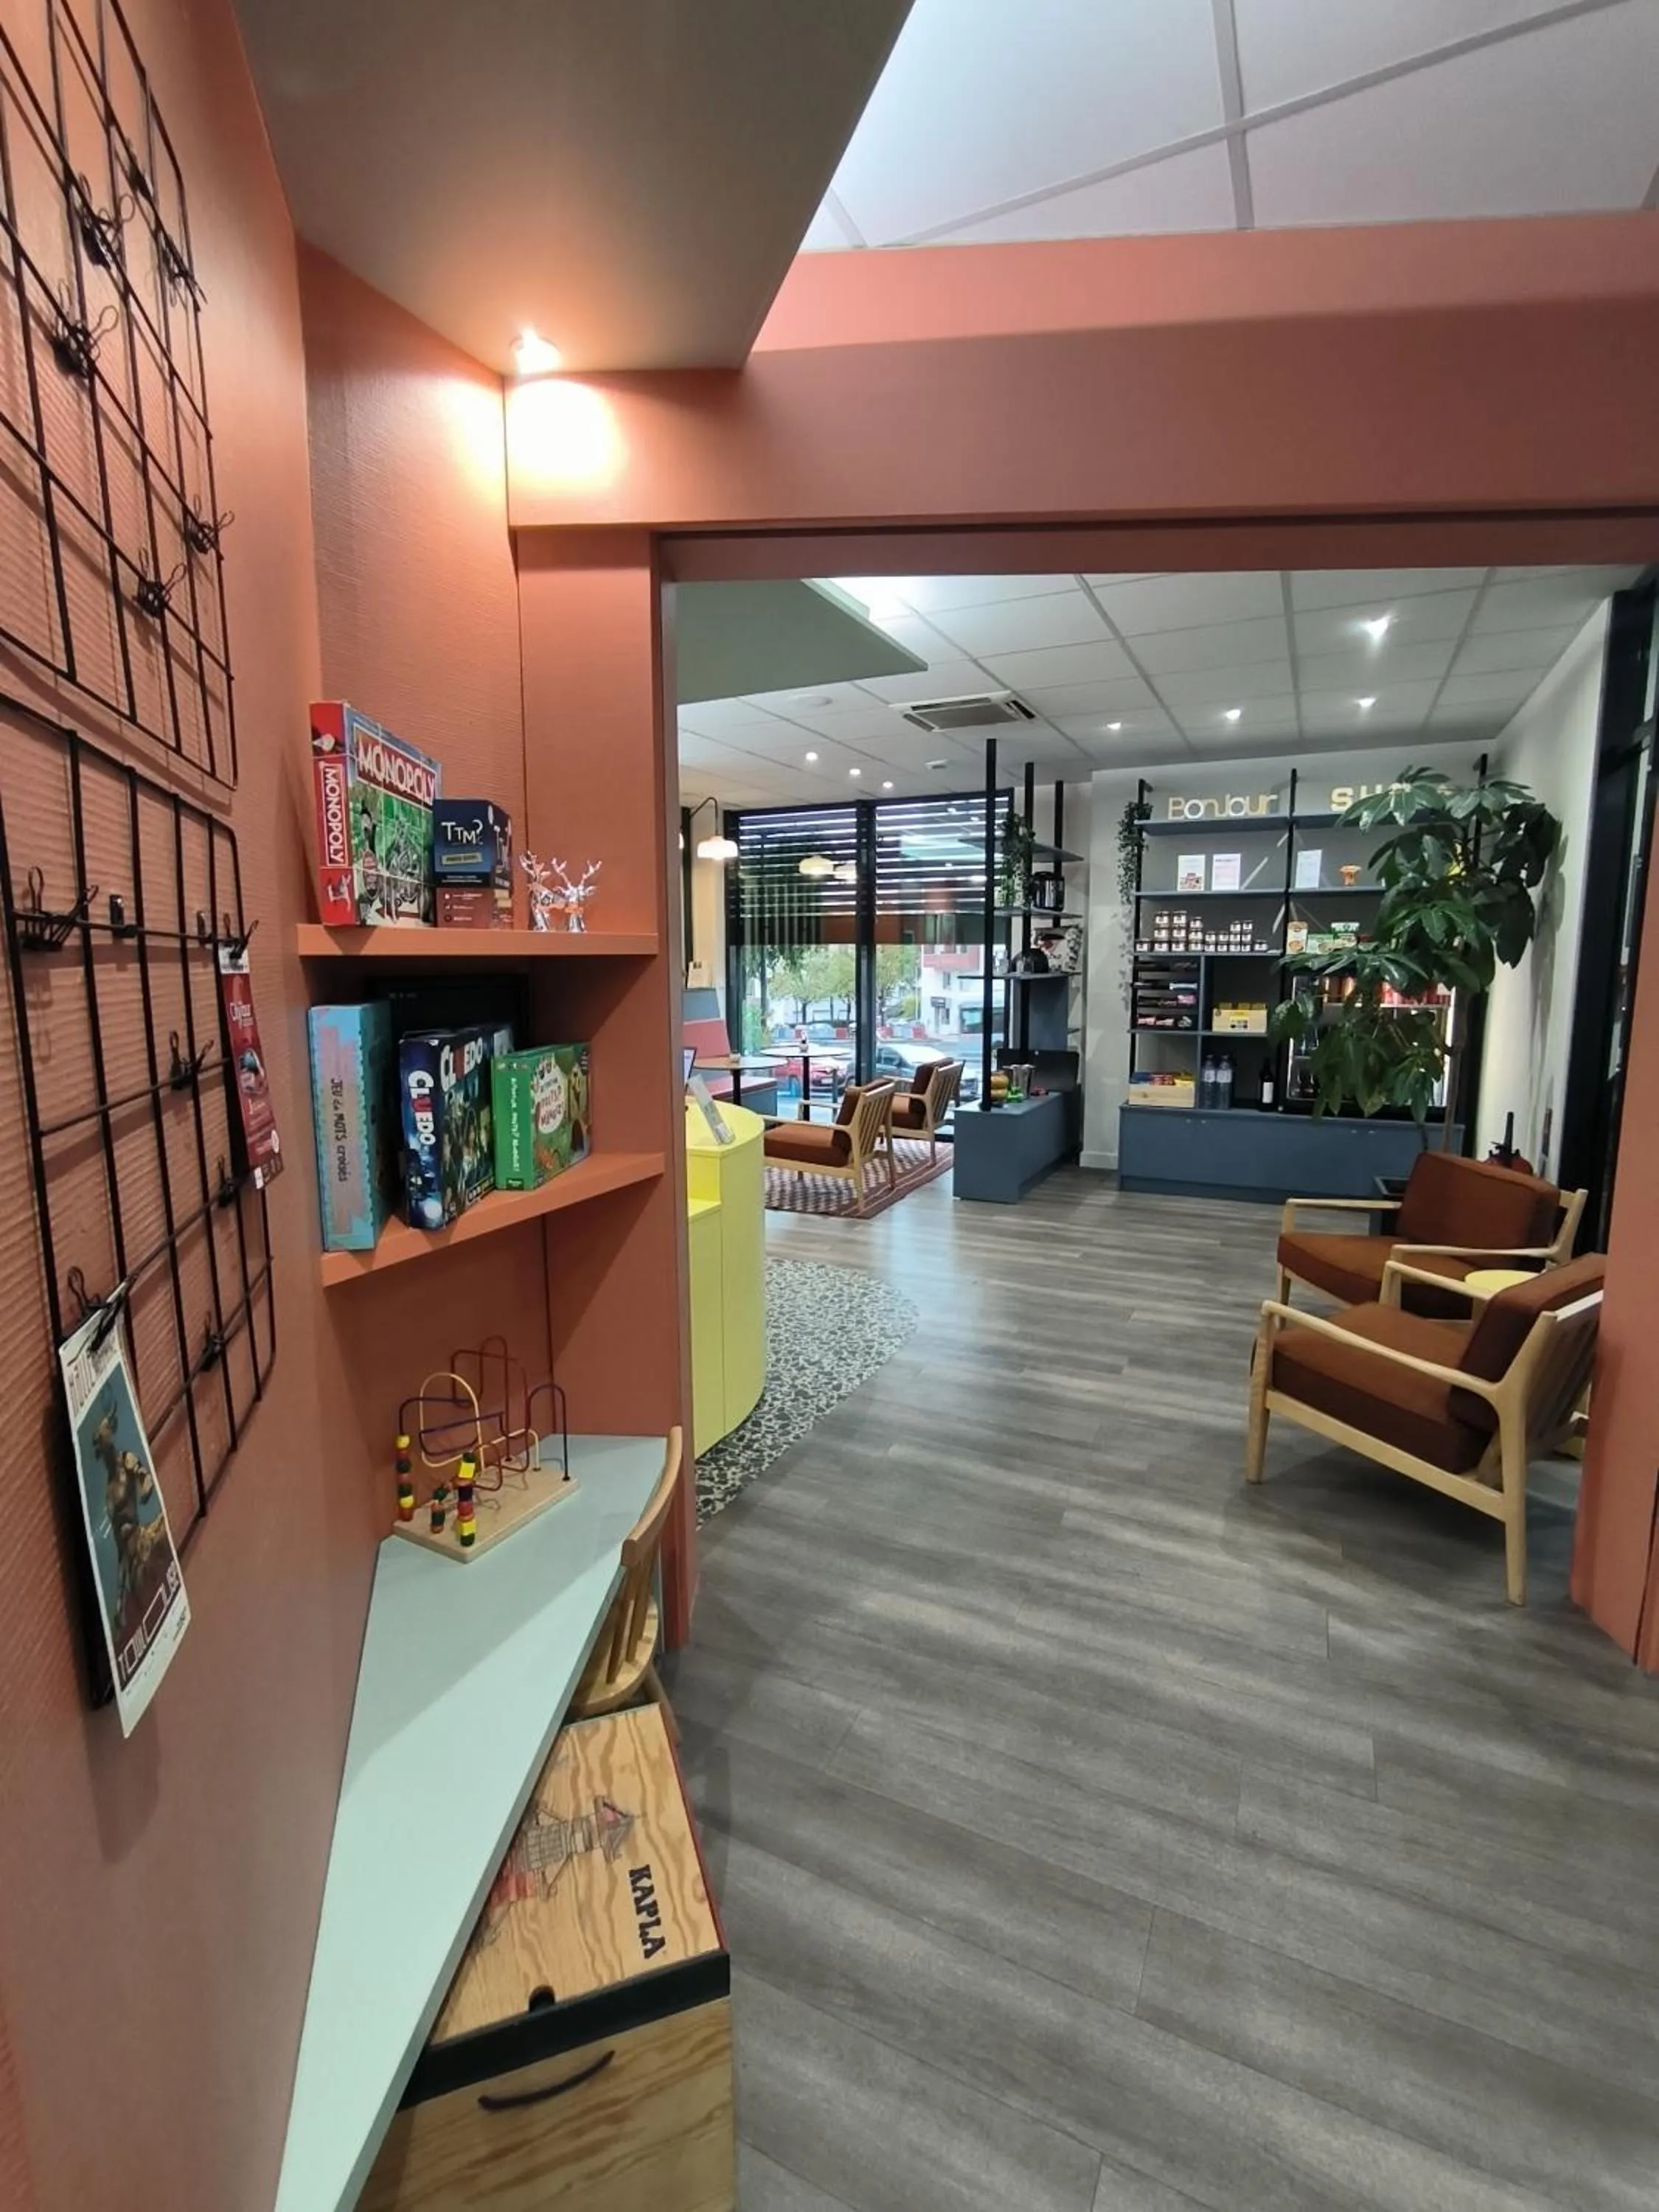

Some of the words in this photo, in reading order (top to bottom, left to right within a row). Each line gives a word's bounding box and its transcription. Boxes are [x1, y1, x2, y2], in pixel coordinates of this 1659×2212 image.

[358, 737, 436, 806] MONOPOLY
[324, 768, 344, 863] MONOPOLY
[331, 1078, 343, 1097] JEU
[441, 1037, 483, 1092] CLUEDO
[334, 1113, 347, 1141] MOTS
[408, 1070, 436, 1146] CLUEDO
[629, 1865, 667, 1959] KAPLA
